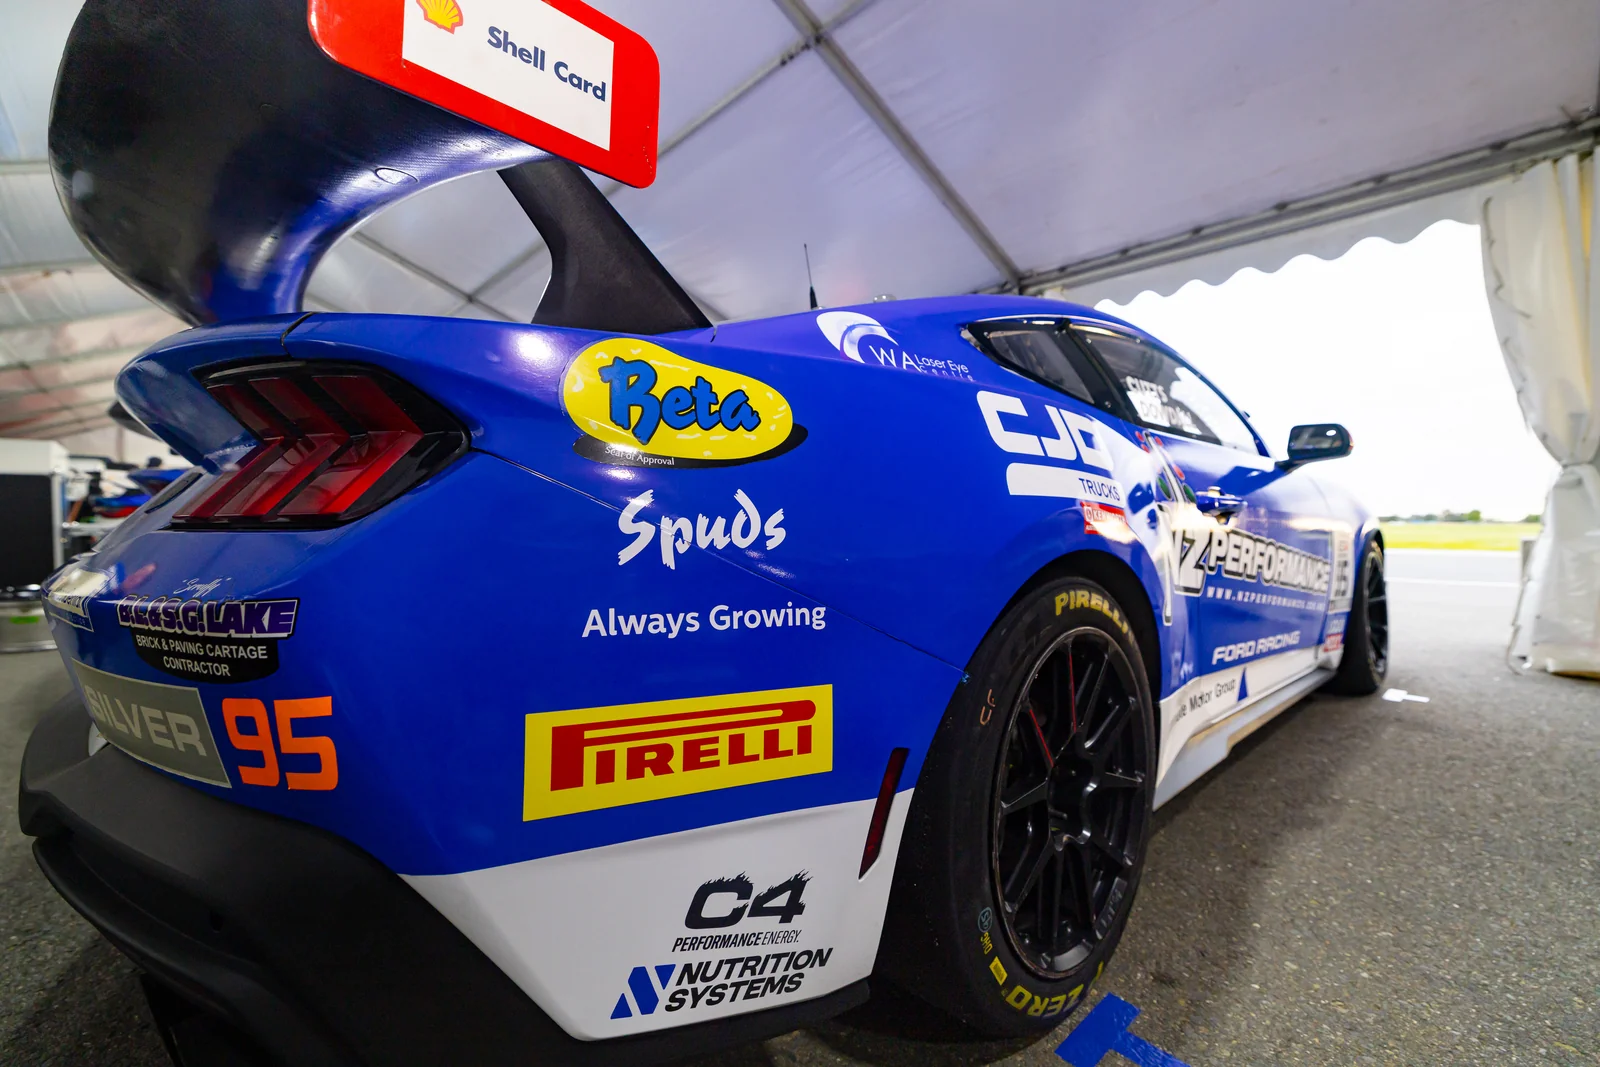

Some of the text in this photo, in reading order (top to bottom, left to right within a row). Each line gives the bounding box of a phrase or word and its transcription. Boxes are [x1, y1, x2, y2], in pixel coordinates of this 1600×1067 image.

[487, 25, 607, 102] Shell Card
[914, 353, 969, 374] Laser Eye
[598, 355, 761, 445] Beta
[976, 390, 1116, 473] CJD
[636, 453, 675, 466] Approval
[1078, 477, 1122, 502] TRUCKS
[618, 488, 787, 570] Spuds
[1208, 527, 1331, 595] PERFORMANCE
[582, 601, 826, 639] Always Growing
[1055, 590, 1130, 635] PIRELLI
[136, 635, 268, 660] BRICK & PAVING CARTAGE
[163, 656, 231, 676] CONTRACTOR
[1211, 641, 1255, 666] FORD
[1255, 630, 1301, 655] RACING
[84, 684, 207, 757] SILVER
[222, 696, 339, 791] 95
[551, 699, 817, 792] PIRELLI
[684, 868, 814, 930] C4
[672, 931, 763, 953] PERFORMANCE
[675, 947, 833, 987] NUTRITION
[664, 972, 805, 1013] SYSTEMS
[1005, 984, 1085, 1018] ZERO
